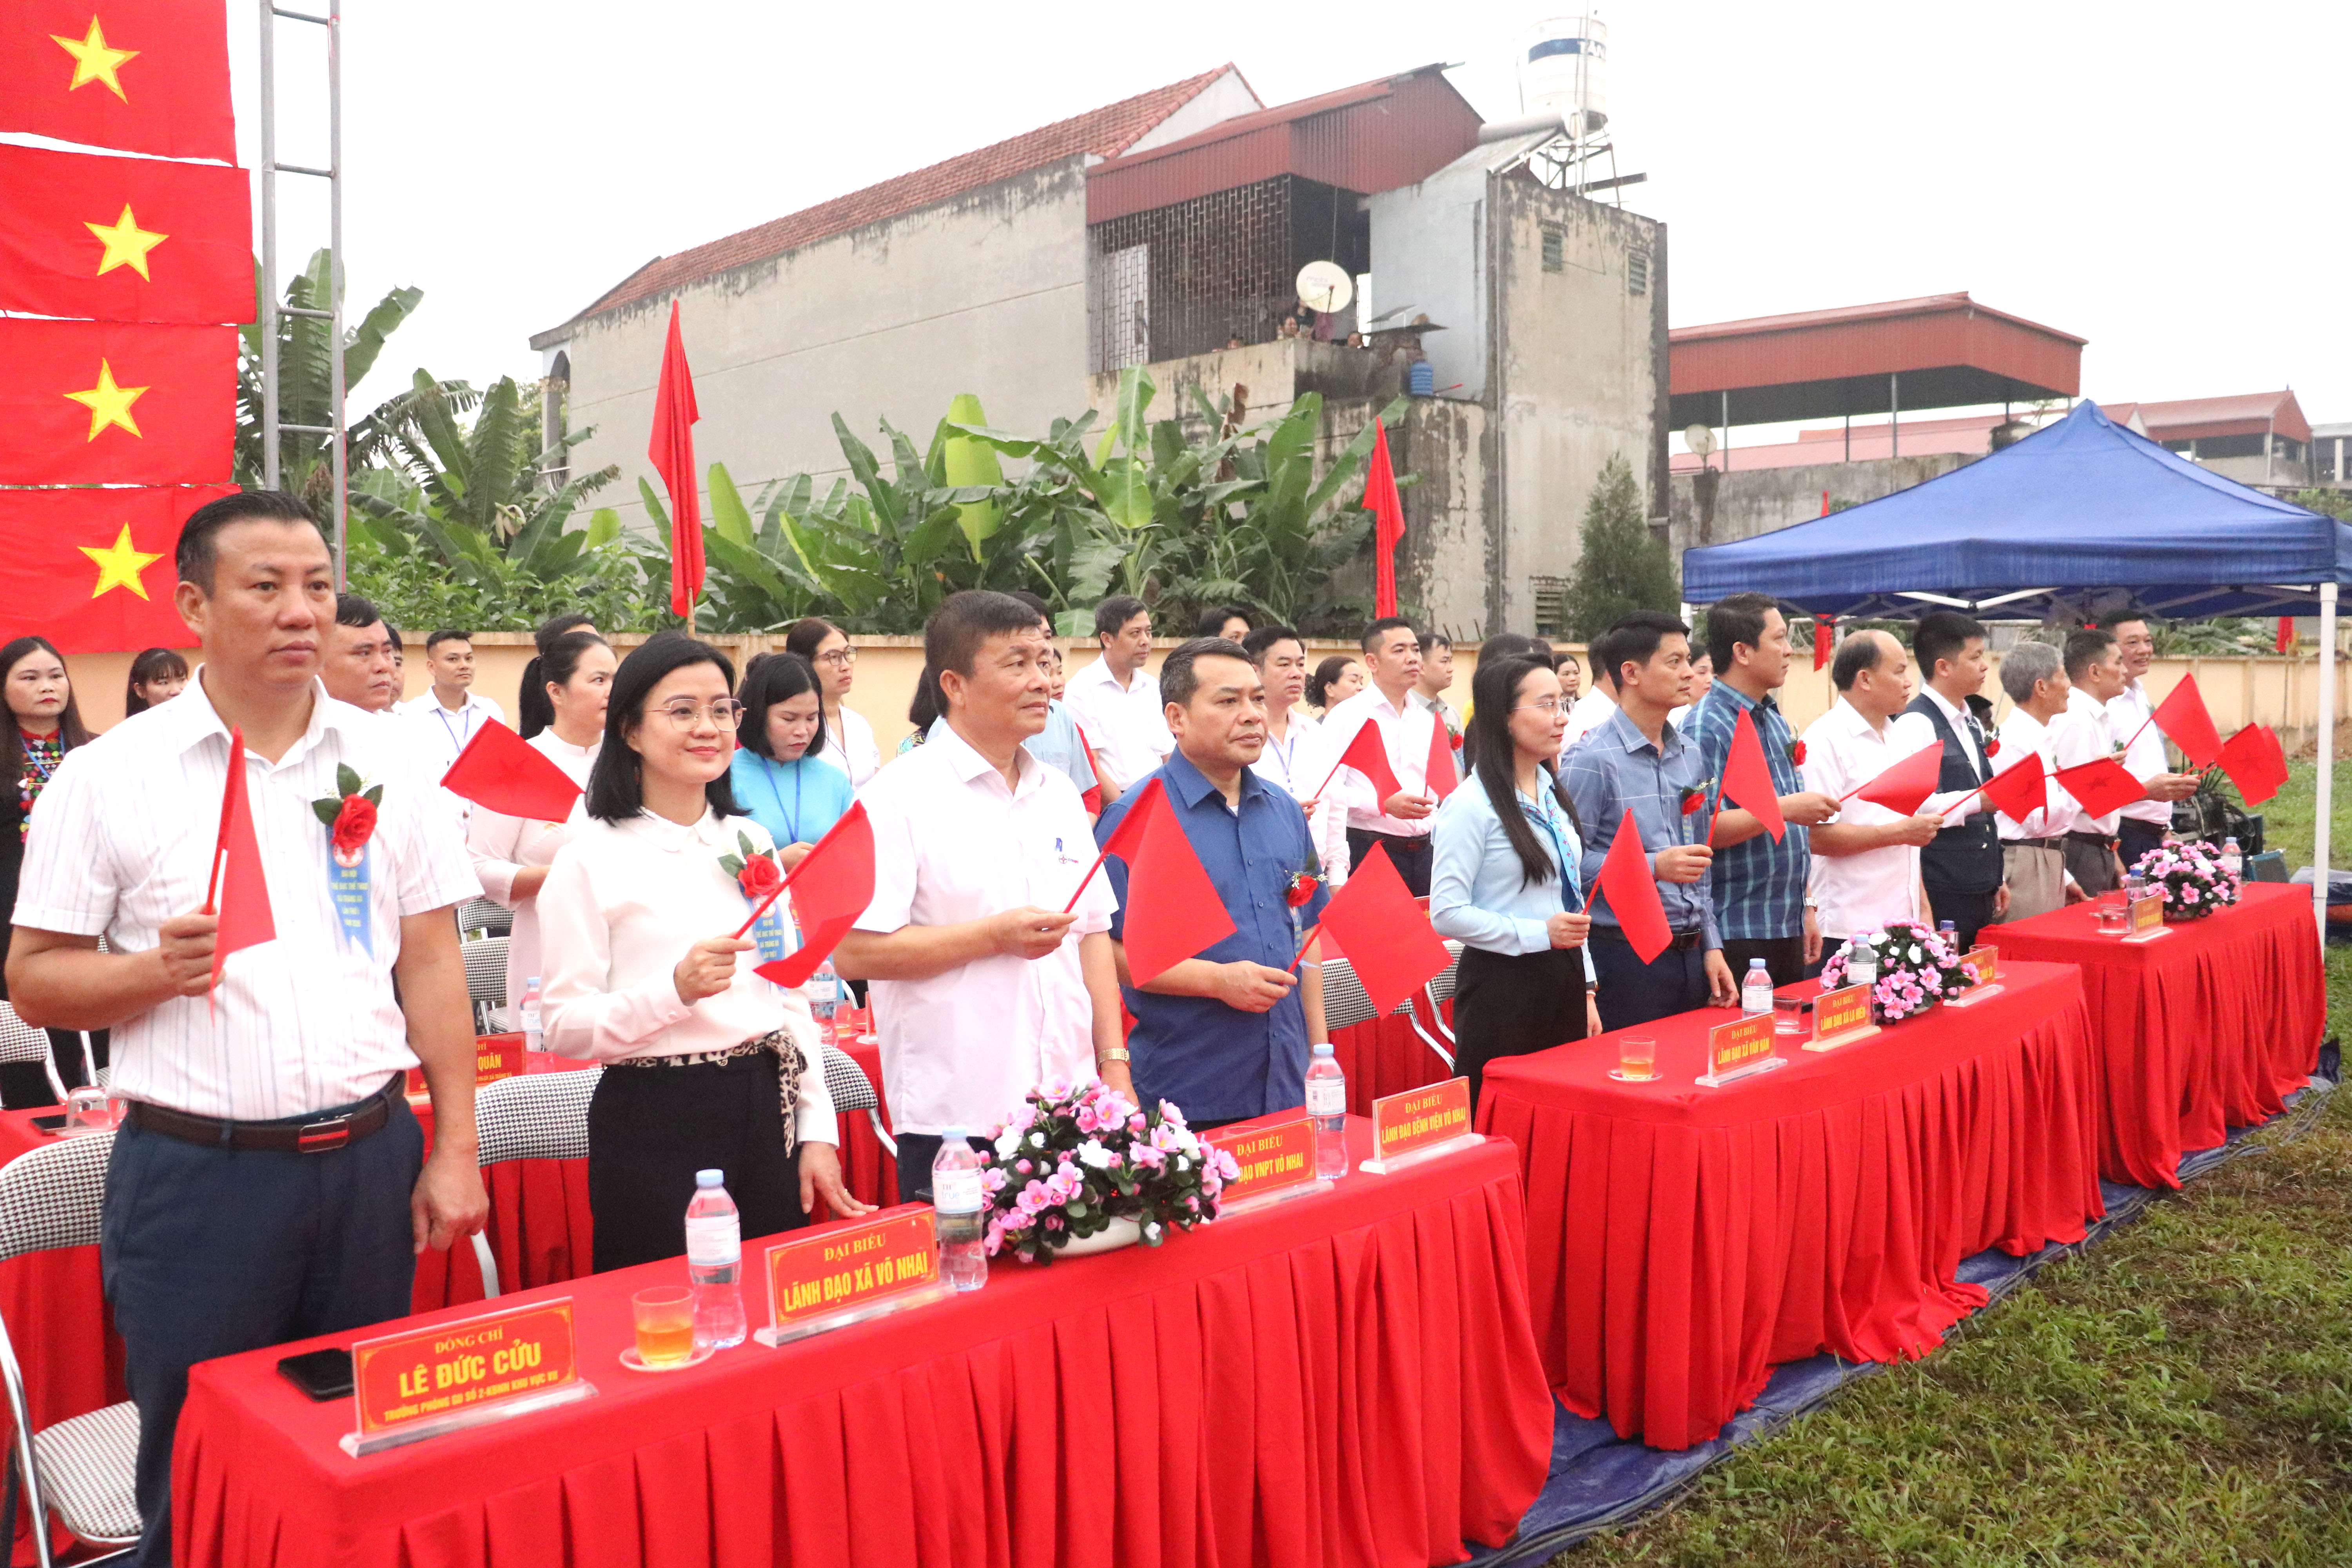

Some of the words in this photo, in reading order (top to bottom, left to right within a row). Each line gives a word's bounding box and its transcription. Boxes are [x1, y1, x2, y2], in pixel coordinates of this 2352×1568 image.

[478, 1052, 501, 1072] QUÂN
[1405, 1100, 1421, 1114] ĐẠI
[1381, 1125, 1398, 1144] LÃNH
[1399, 1122, 1411, 1141] ĐẠO
[1412, 1116, 1428, 1137] BỆNH
[1429, 1111, 1443, 1132] VIỆN
[1443, 1108, 1452, 1126] VÕ
[1452, 1107, 1466, 1123] NHAI
[1237, 1141, 1256, 1157] ĐẠI
[1238, 1164, 1253, 1185] ĐẠO
[1254, 1159, 1274, 1178] VNPT
[1275, 1154, 1285, 1173] VÕ
[1286, 1152, 1304, 1171] NHAI
[824, 1242, 850, 1262] ĐẠI
[783, 1281, 821, 1312] LÃNH
[823, 1272, 851, 1303] ĐẠO
[854, 1261, 874, 1292] XÃ
[875, 1256, 894, 1286] VÕ
[896, 1250, 928, 1281] NHAI
[477, 1325, 503, 1344] CHÍ
[399, 1363, 429, 1398] LÊ
[436, 1354, 486, 1389] ĐỨC
[493, 1338, 541, 1375] CỬU
[465, 1385, 477, 1402] SỐ
